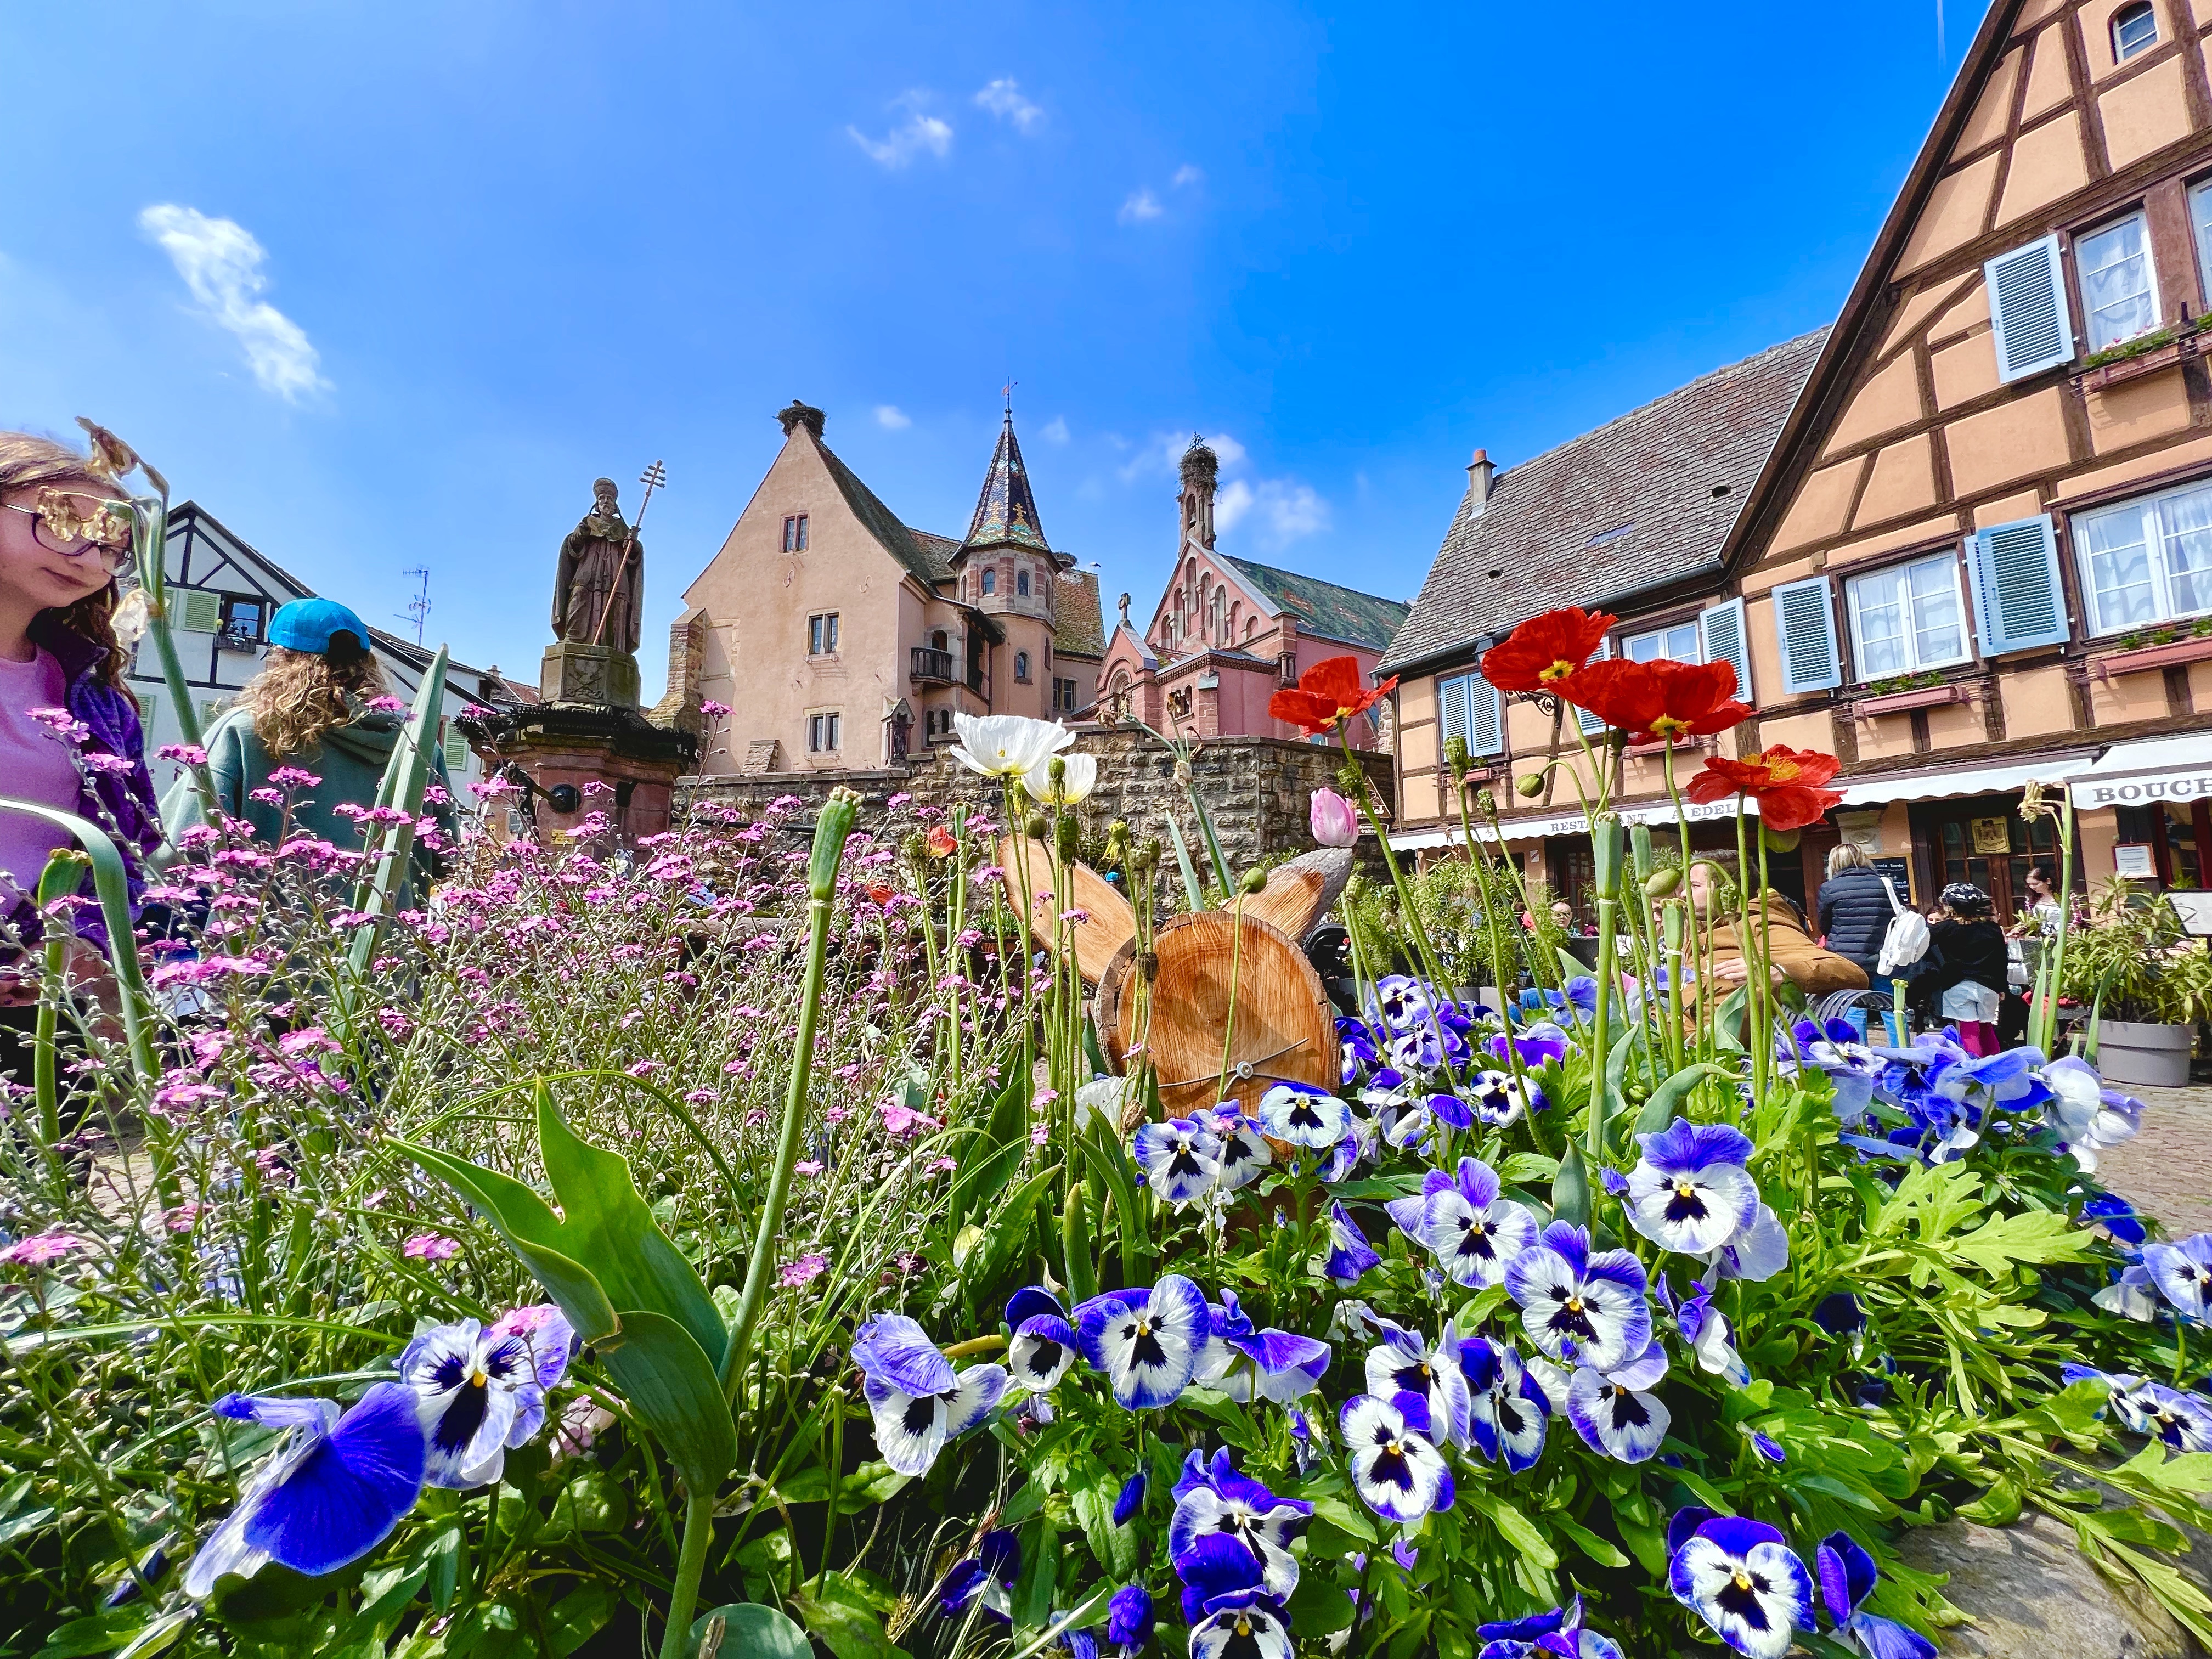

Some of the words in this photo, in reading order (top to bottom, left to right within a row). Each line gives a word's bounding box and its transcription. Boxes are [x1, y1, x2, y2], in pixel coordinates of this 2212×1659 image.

[2092, 778, 2212, 803] BOUCH
[1550, 813, 1647, 832] RESTANT
[1691, 804, 1736, 817] EDEL
